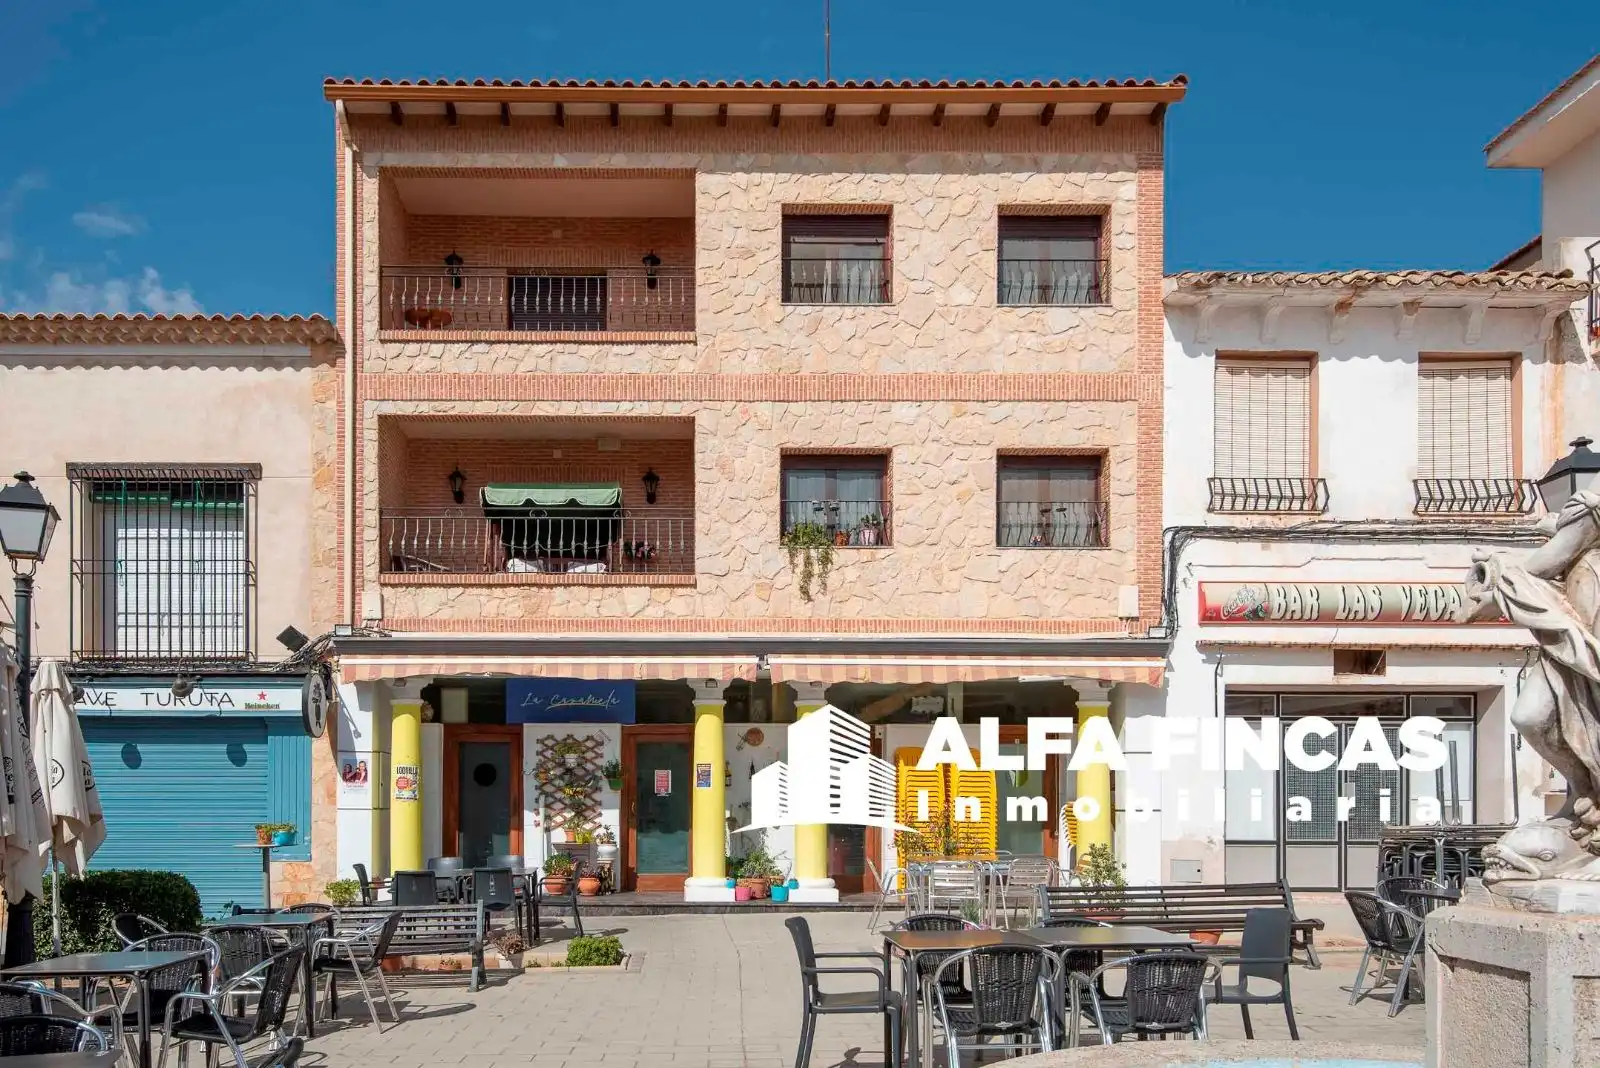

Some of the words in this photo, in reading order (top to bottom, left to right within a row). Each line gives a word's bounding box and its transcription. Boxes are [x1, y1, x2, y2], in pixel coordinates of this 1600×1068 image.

[1270, 584, 1320, 621] BAR
[1335, 584, 1383, 621] LAS
[1400, 584, 1462, 622] VEGA
[140, 692, 235, 708] TURUTA
[244, 702, 280, 710] Heineken
